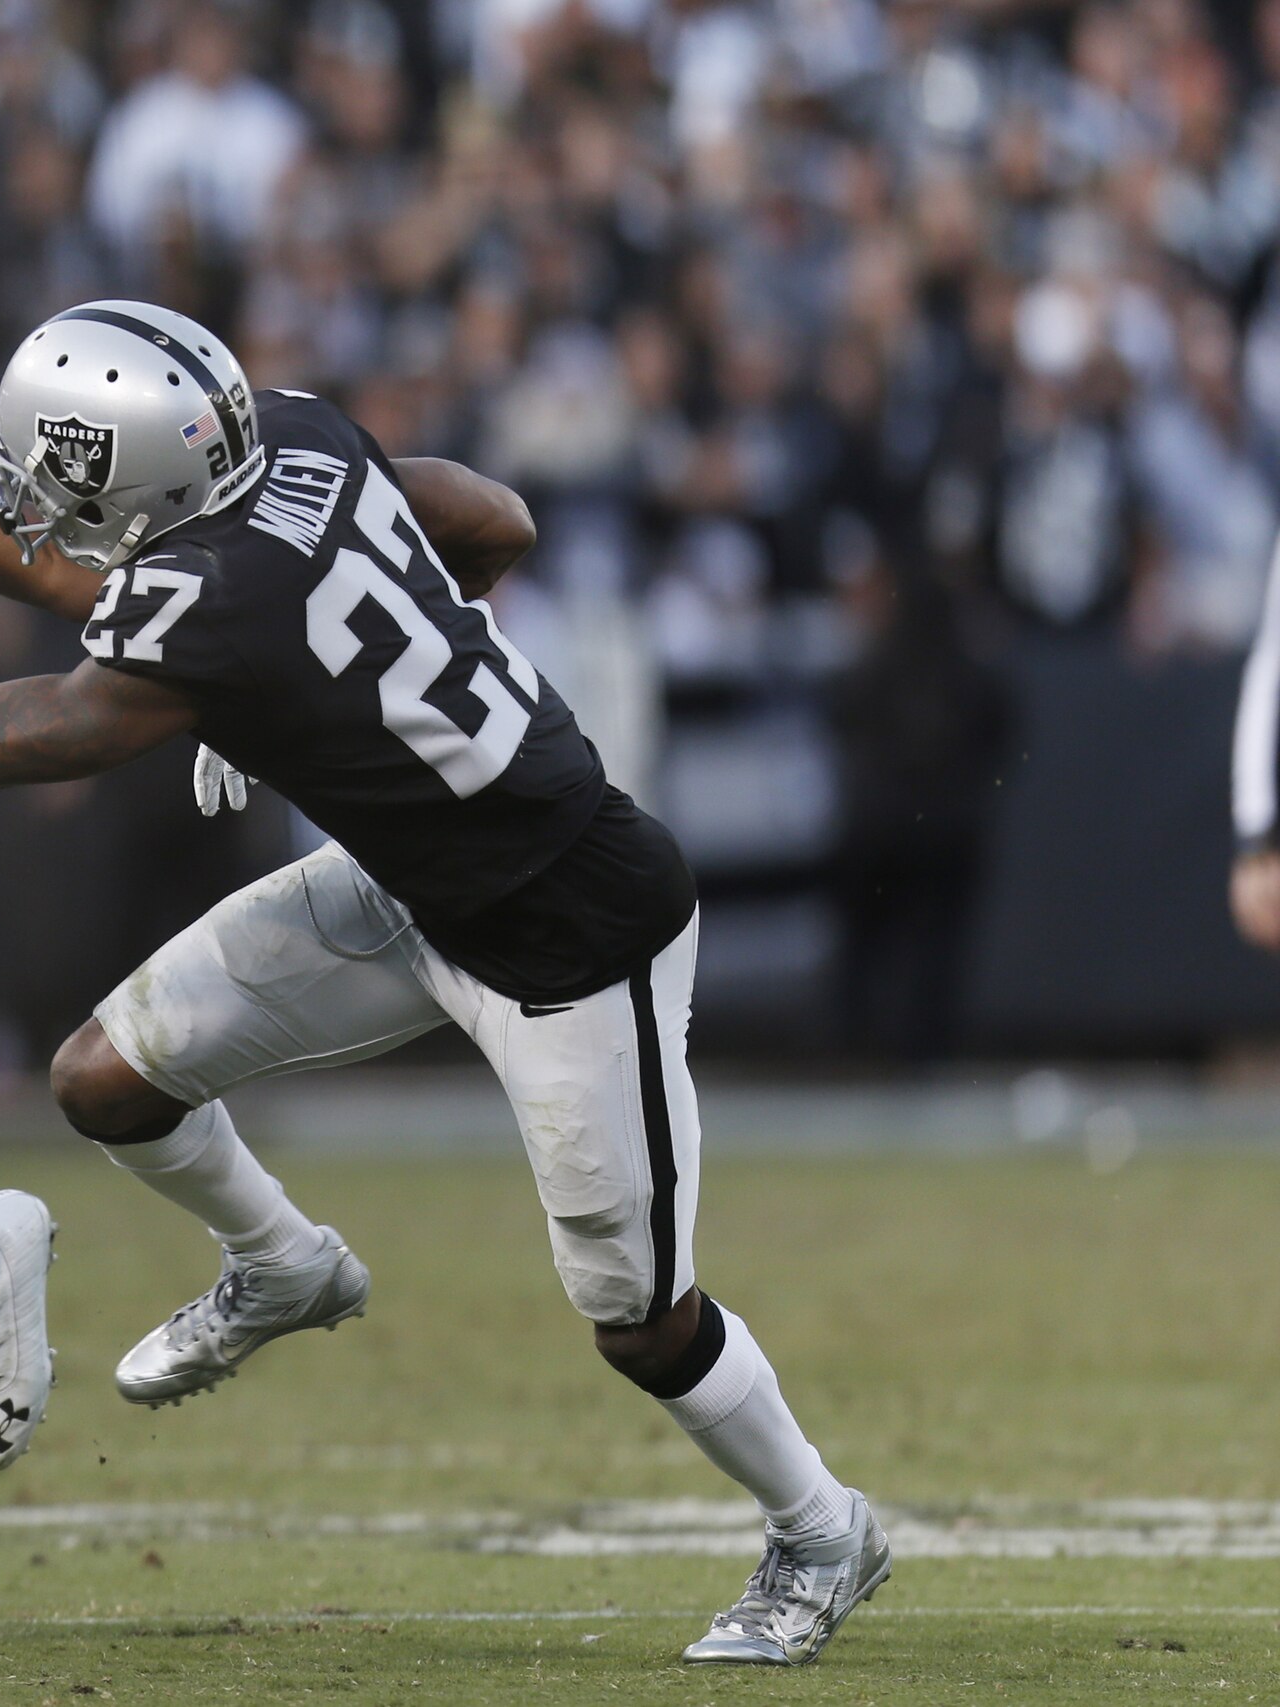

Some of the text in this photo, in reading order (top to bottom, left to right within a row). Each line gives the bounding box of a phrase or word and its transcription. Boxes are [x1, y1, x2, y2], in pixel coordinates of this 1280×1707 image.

[43, 422, 106, 442] RAIDERS
[247, 447, 350, 559] MULLEN
[80, 566, 204, 663] 27
[305, 457, 540, 800] 27
